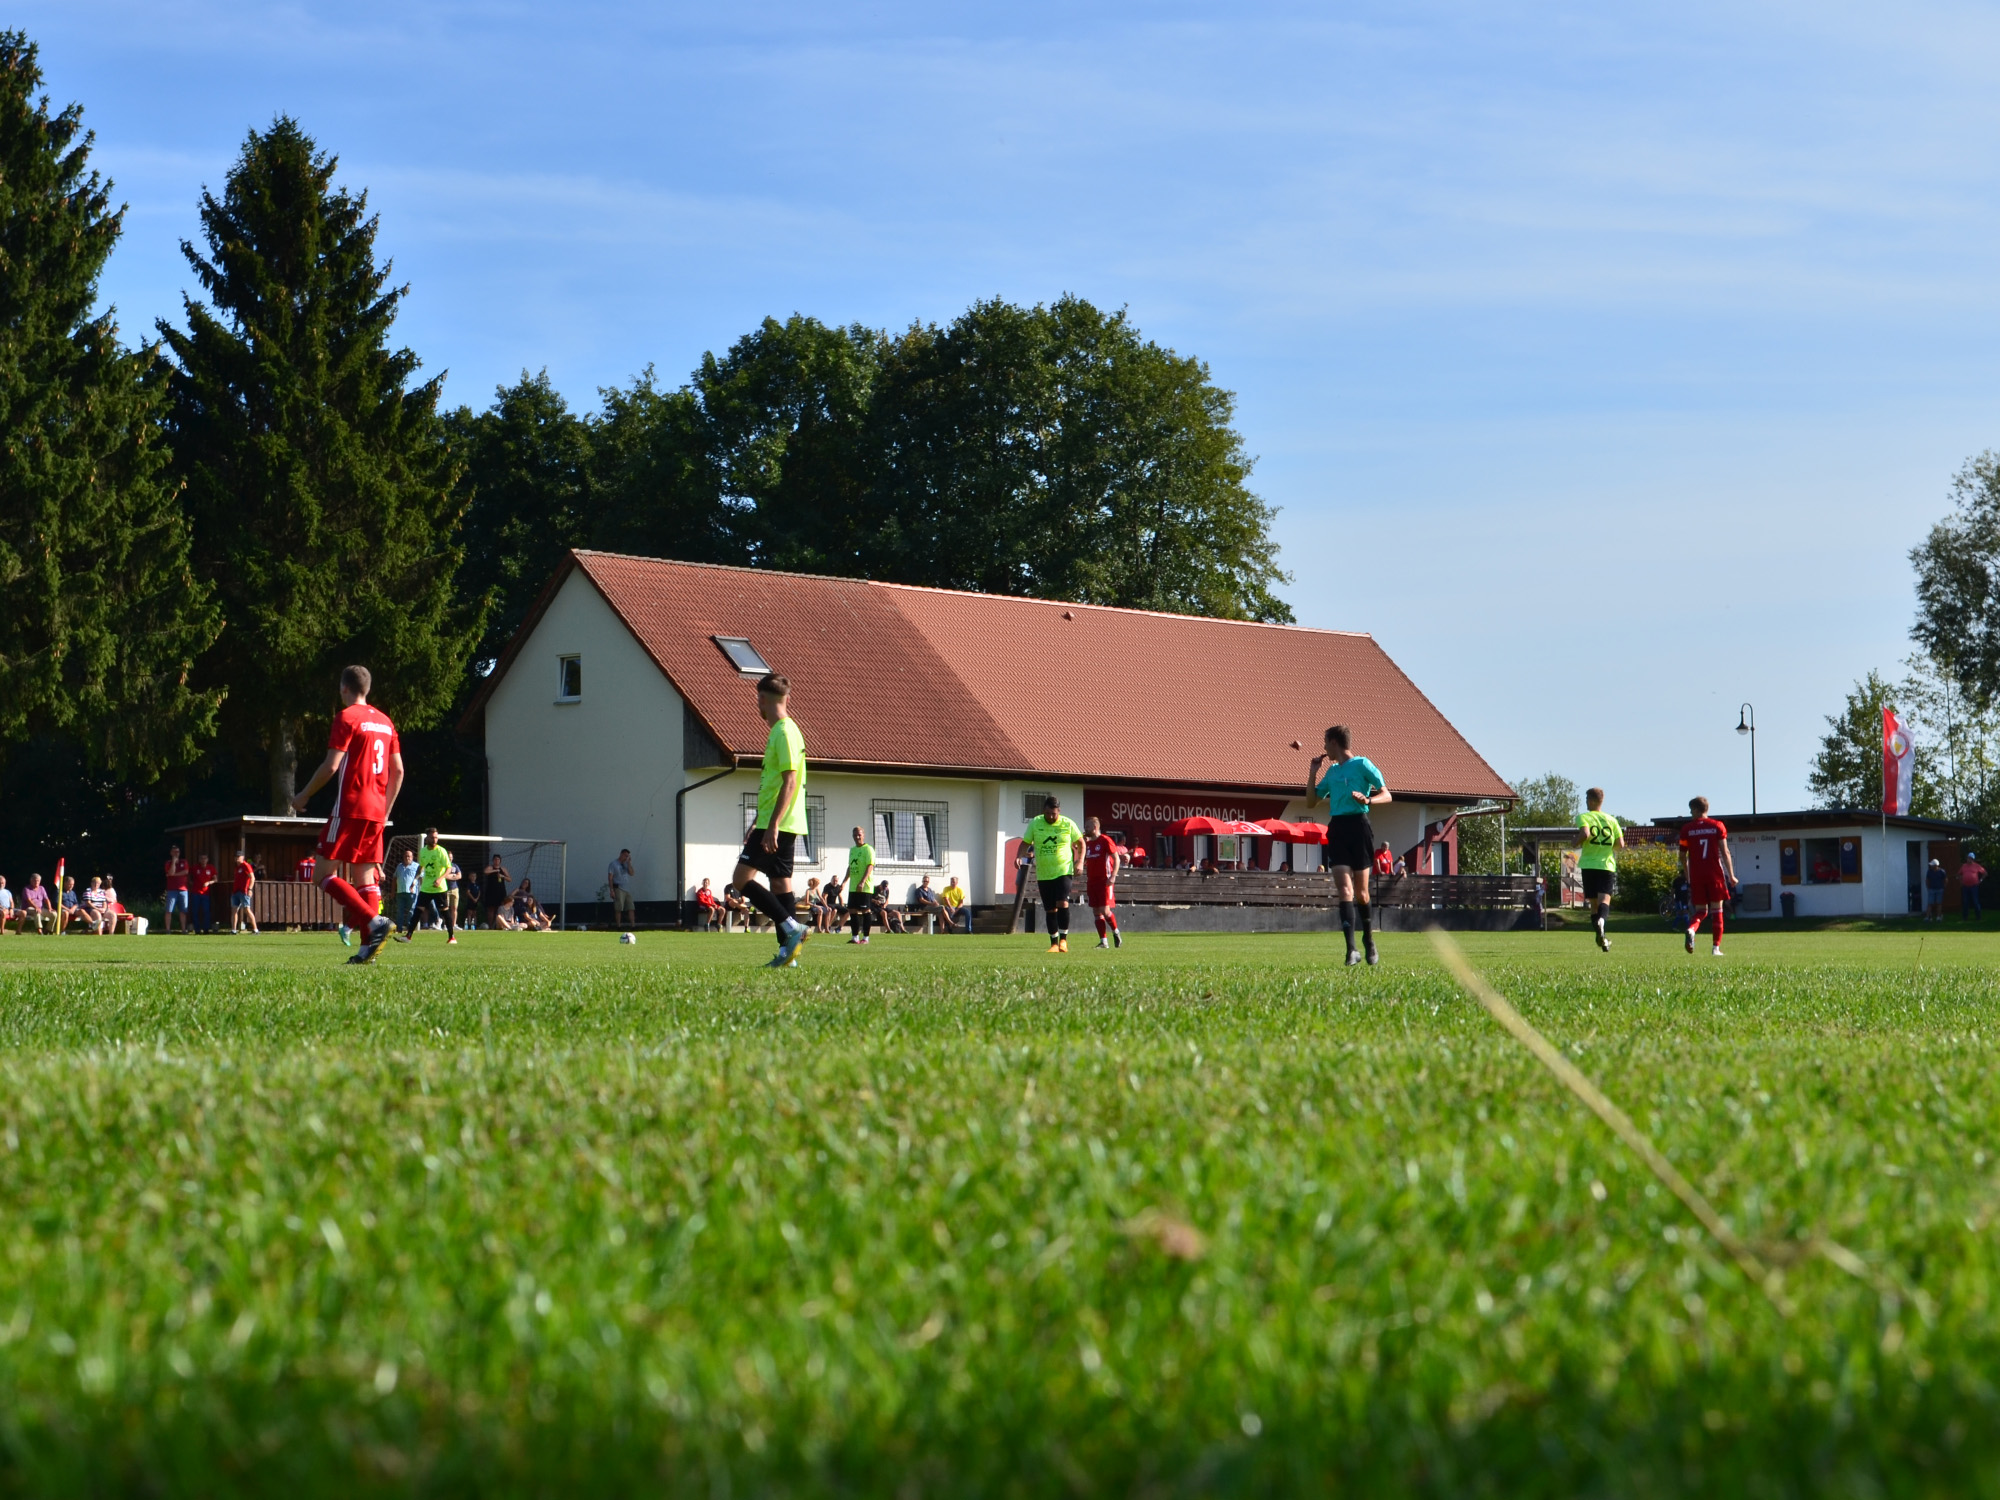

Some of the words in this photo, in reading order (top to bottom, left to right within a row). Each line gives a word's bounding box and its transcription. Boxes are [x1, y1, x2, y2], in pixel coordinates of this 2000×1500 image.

[373, 739, 384, 775] 3
[1111, 802, 1152, 821] SPVGG
[1154, 804, 1246, 822] GOLDKRONACH
[1589, 825, 1612, 846] 22
[1699, 839, 1709, 859] 7
